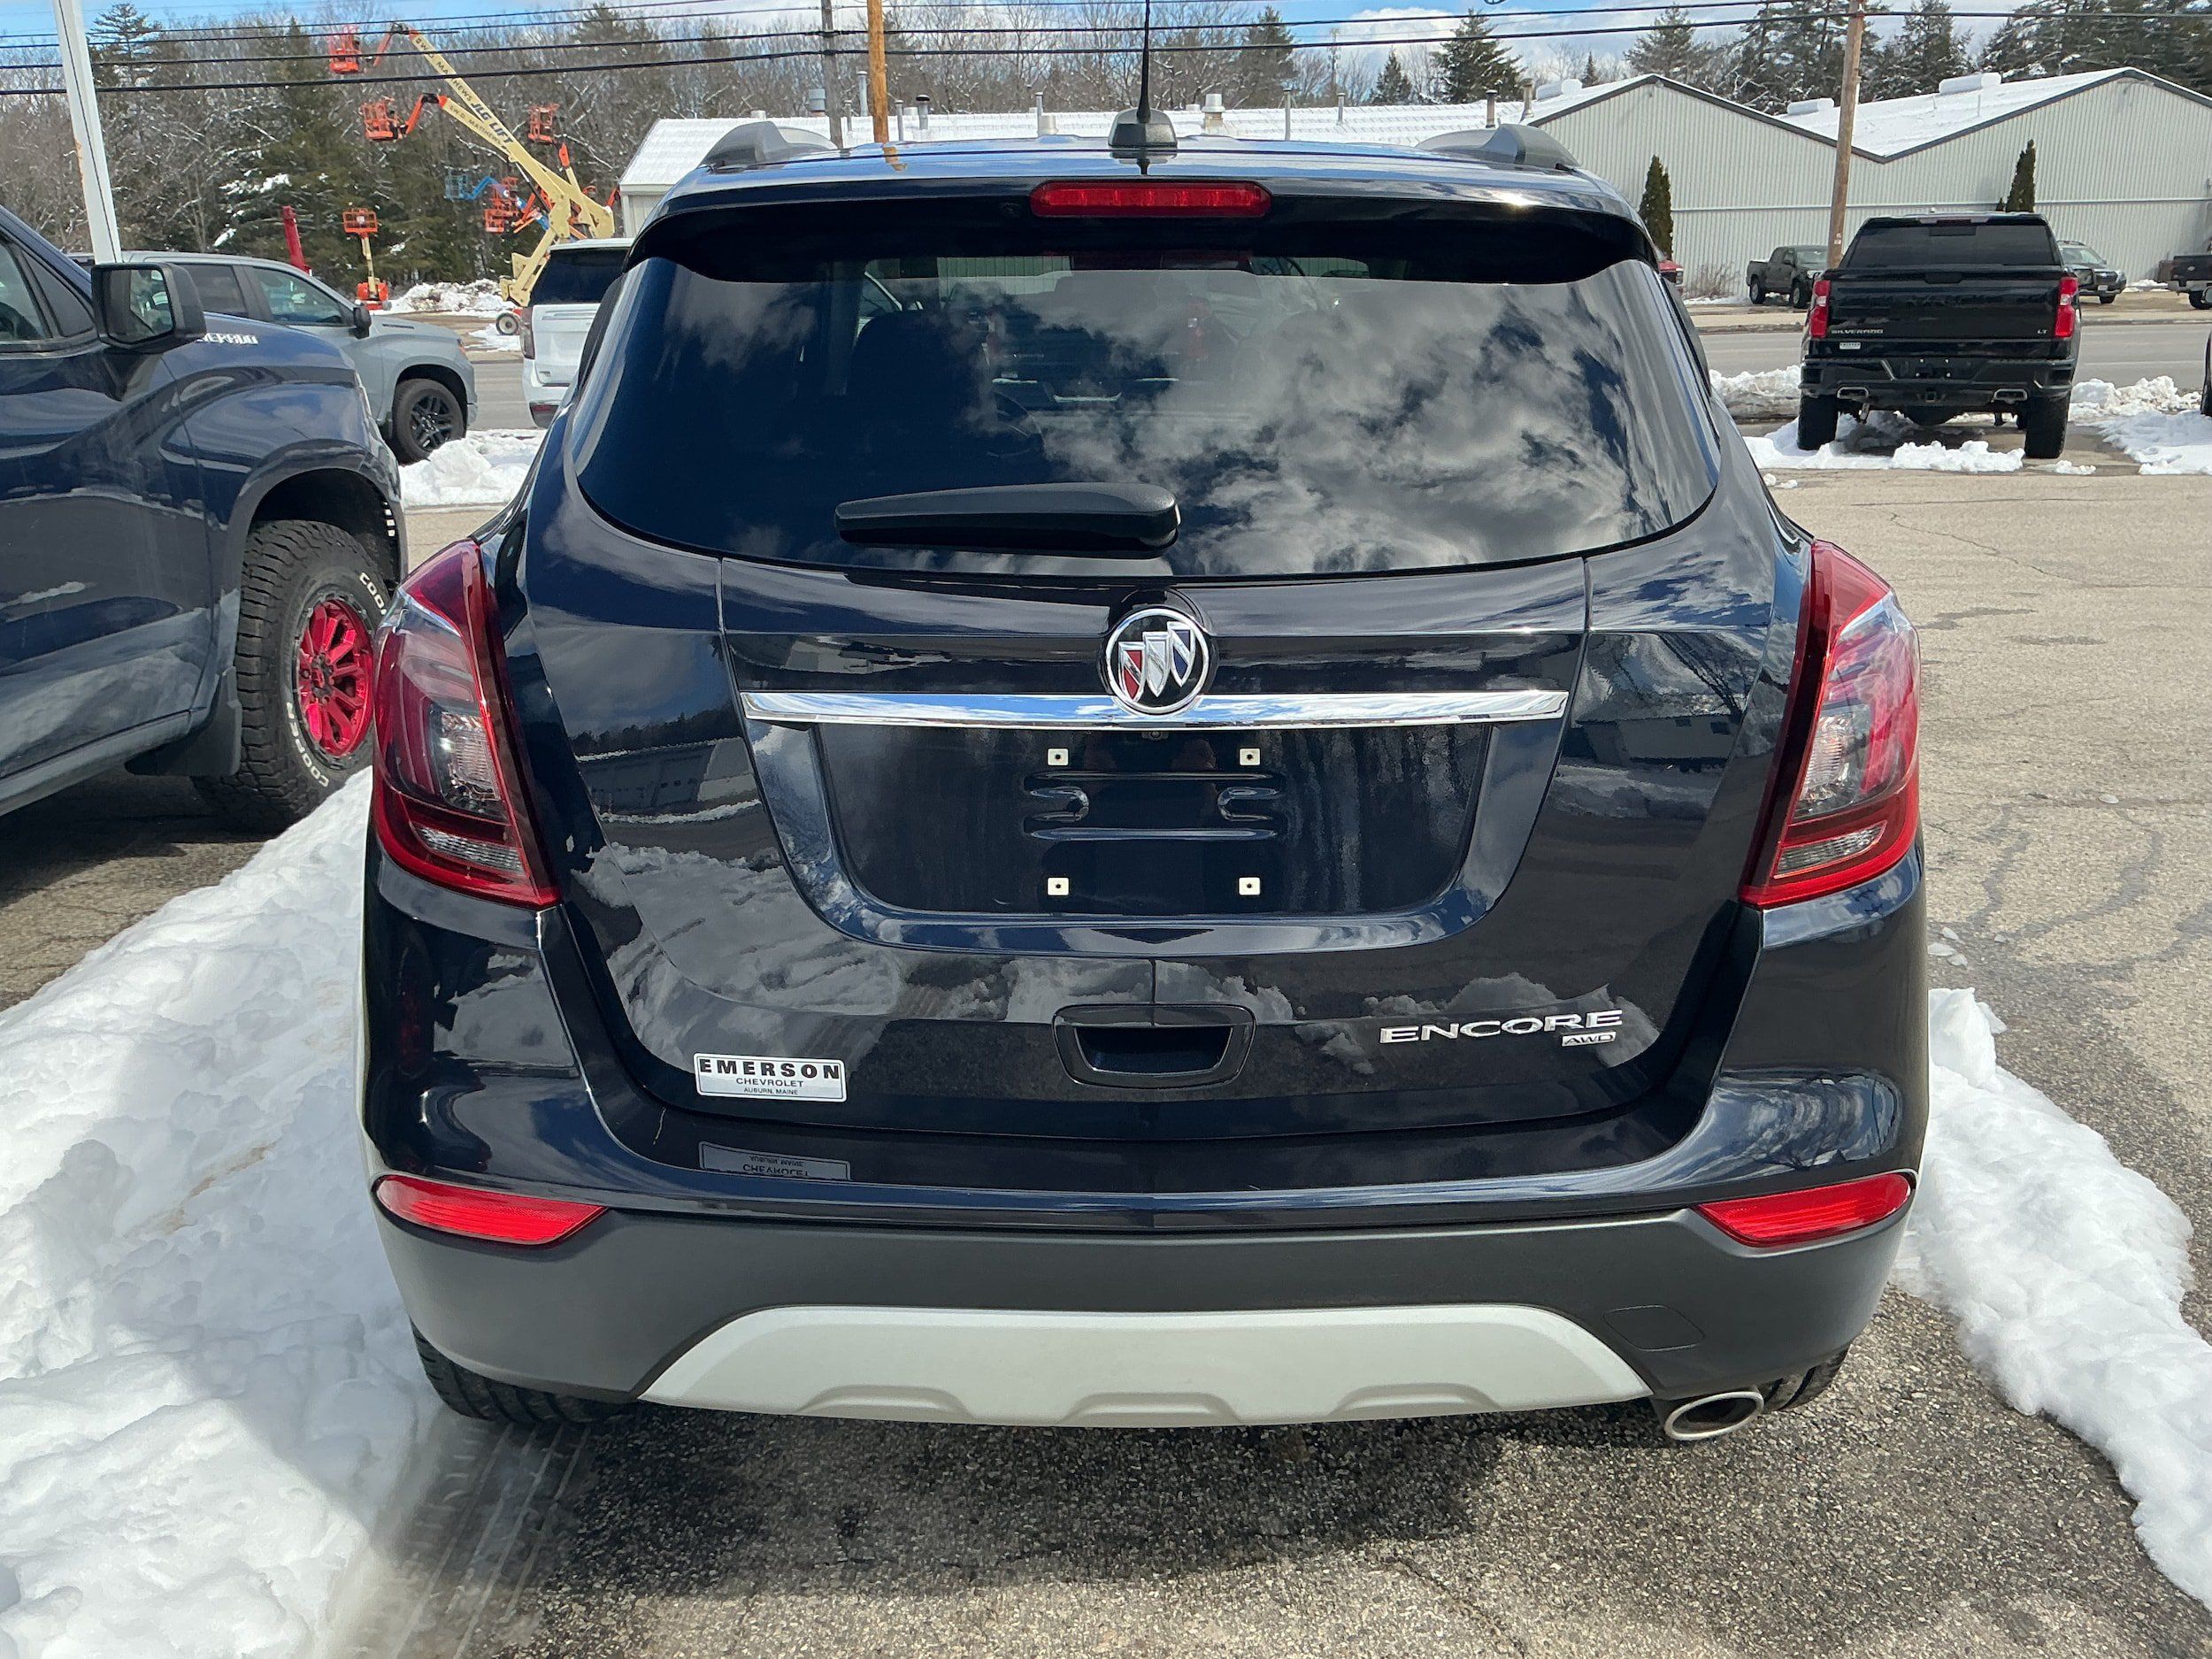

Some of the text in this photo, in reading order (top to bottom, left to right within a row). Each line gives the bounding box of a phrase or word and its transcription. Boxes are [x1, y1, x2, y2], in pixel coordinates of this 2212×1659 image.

[436, 61, 472, 102] MAHEWS
[471, 103, 513, 142] JLG LIFT
[1379, 1010, 1623, 1044] ENCORE
[1563, 1033, 1615, 1046] AWD
[698, 1058, 840, 1079] EMERSON
[735, 1077, 804, 1087] CHEVROLET
